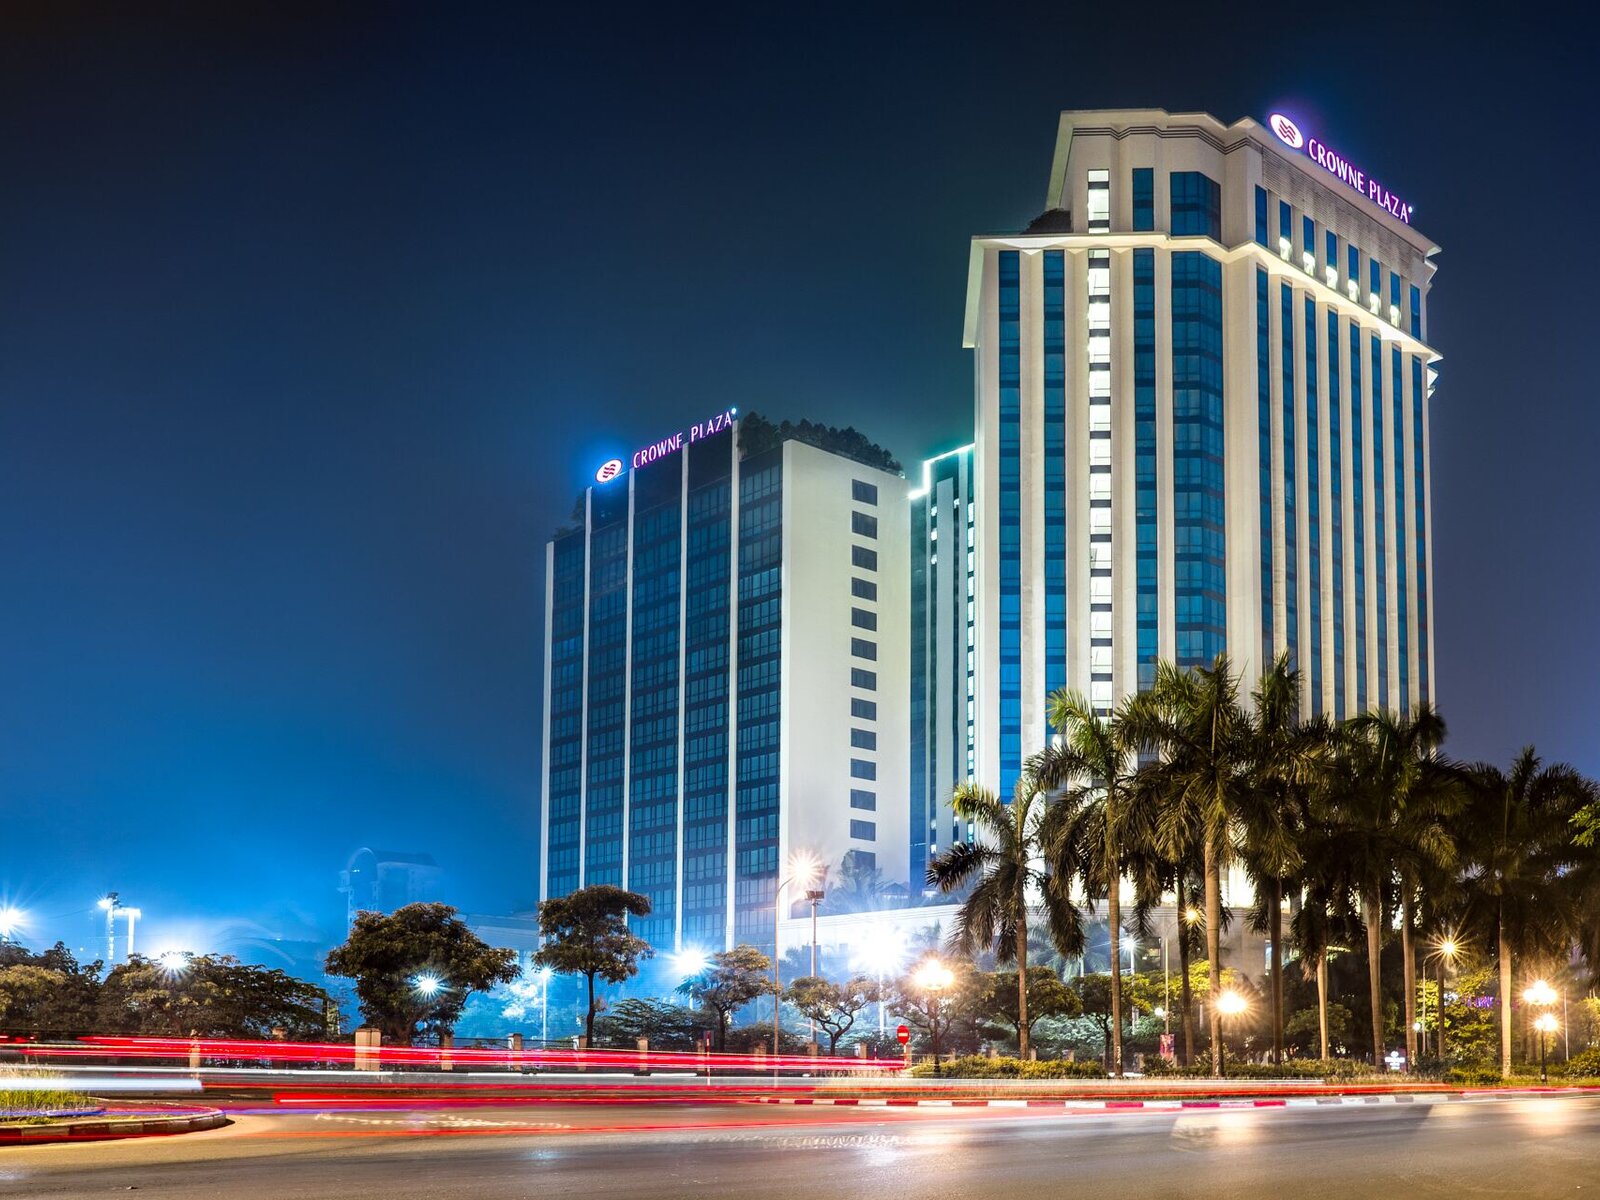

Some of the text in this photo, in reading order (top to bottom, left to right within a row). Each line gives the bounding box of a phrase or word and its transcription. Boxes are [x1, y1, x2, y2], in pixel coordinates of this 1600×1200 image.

[1309, 139, 1409, 224] CROWNE PLAZA
[633, 411, 732, 468] CROWNE PLAZA
